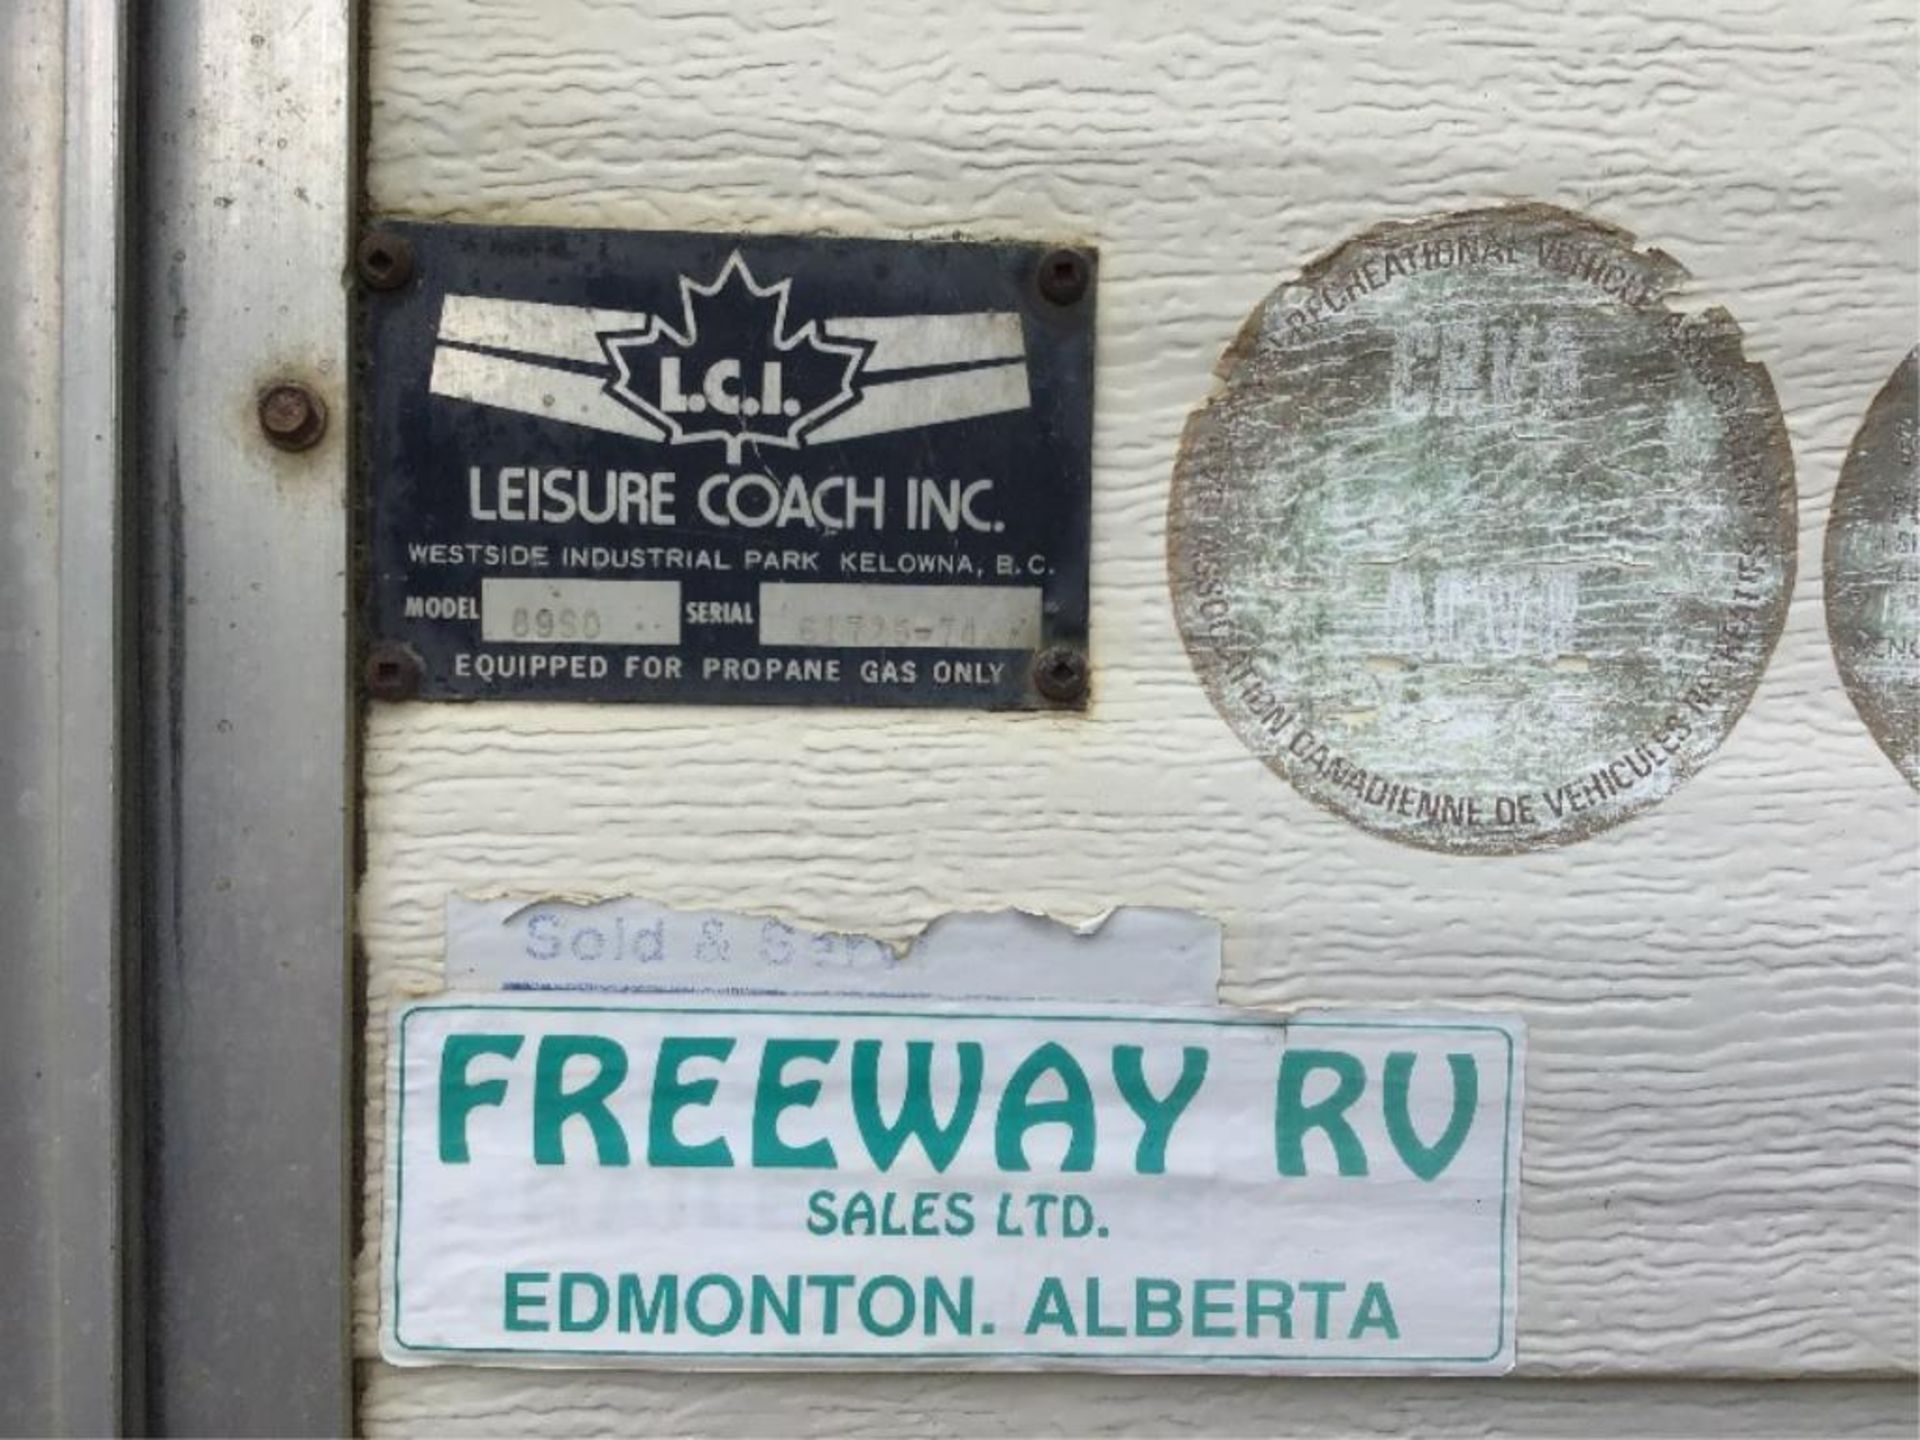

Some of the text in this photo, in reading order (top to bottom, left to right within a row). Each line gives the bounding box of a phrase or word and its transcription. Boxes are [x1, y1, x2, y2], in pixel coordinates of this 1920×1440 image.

[660, 356, 801, 417] L.C.I.
[471, 467, 1005, 532] LEISURE COACH INC.
[408, 543, 549, 566] WESTSIDE
[562, 547, 732, 570] INDUSTRIAL
[745, 550, 820, 571] PARK
[840, 552, 983, 577] KELOWNA,
[405, 597, 479, 619] MODEL
[686, 601, 754, 624] SERIAL
[455, 653, 1005, 685] EQUIPPED FOR PROPANE GAS ONLY
[1287, 727, 1487, 826] CANADIENNE
[1494, 796, 1537, 826] DE
[1541, 713, 1692, 818] VEHICULES
[525, 913, 664, 962] Sold
[698, 917, 731, 962] &
[436, 1032, 1480, 1182] FREEWAY RV
[806, 1189, 1110, 1239] SALES LTD.
[1024, 1275, 1399, 1342] ALBERTA
